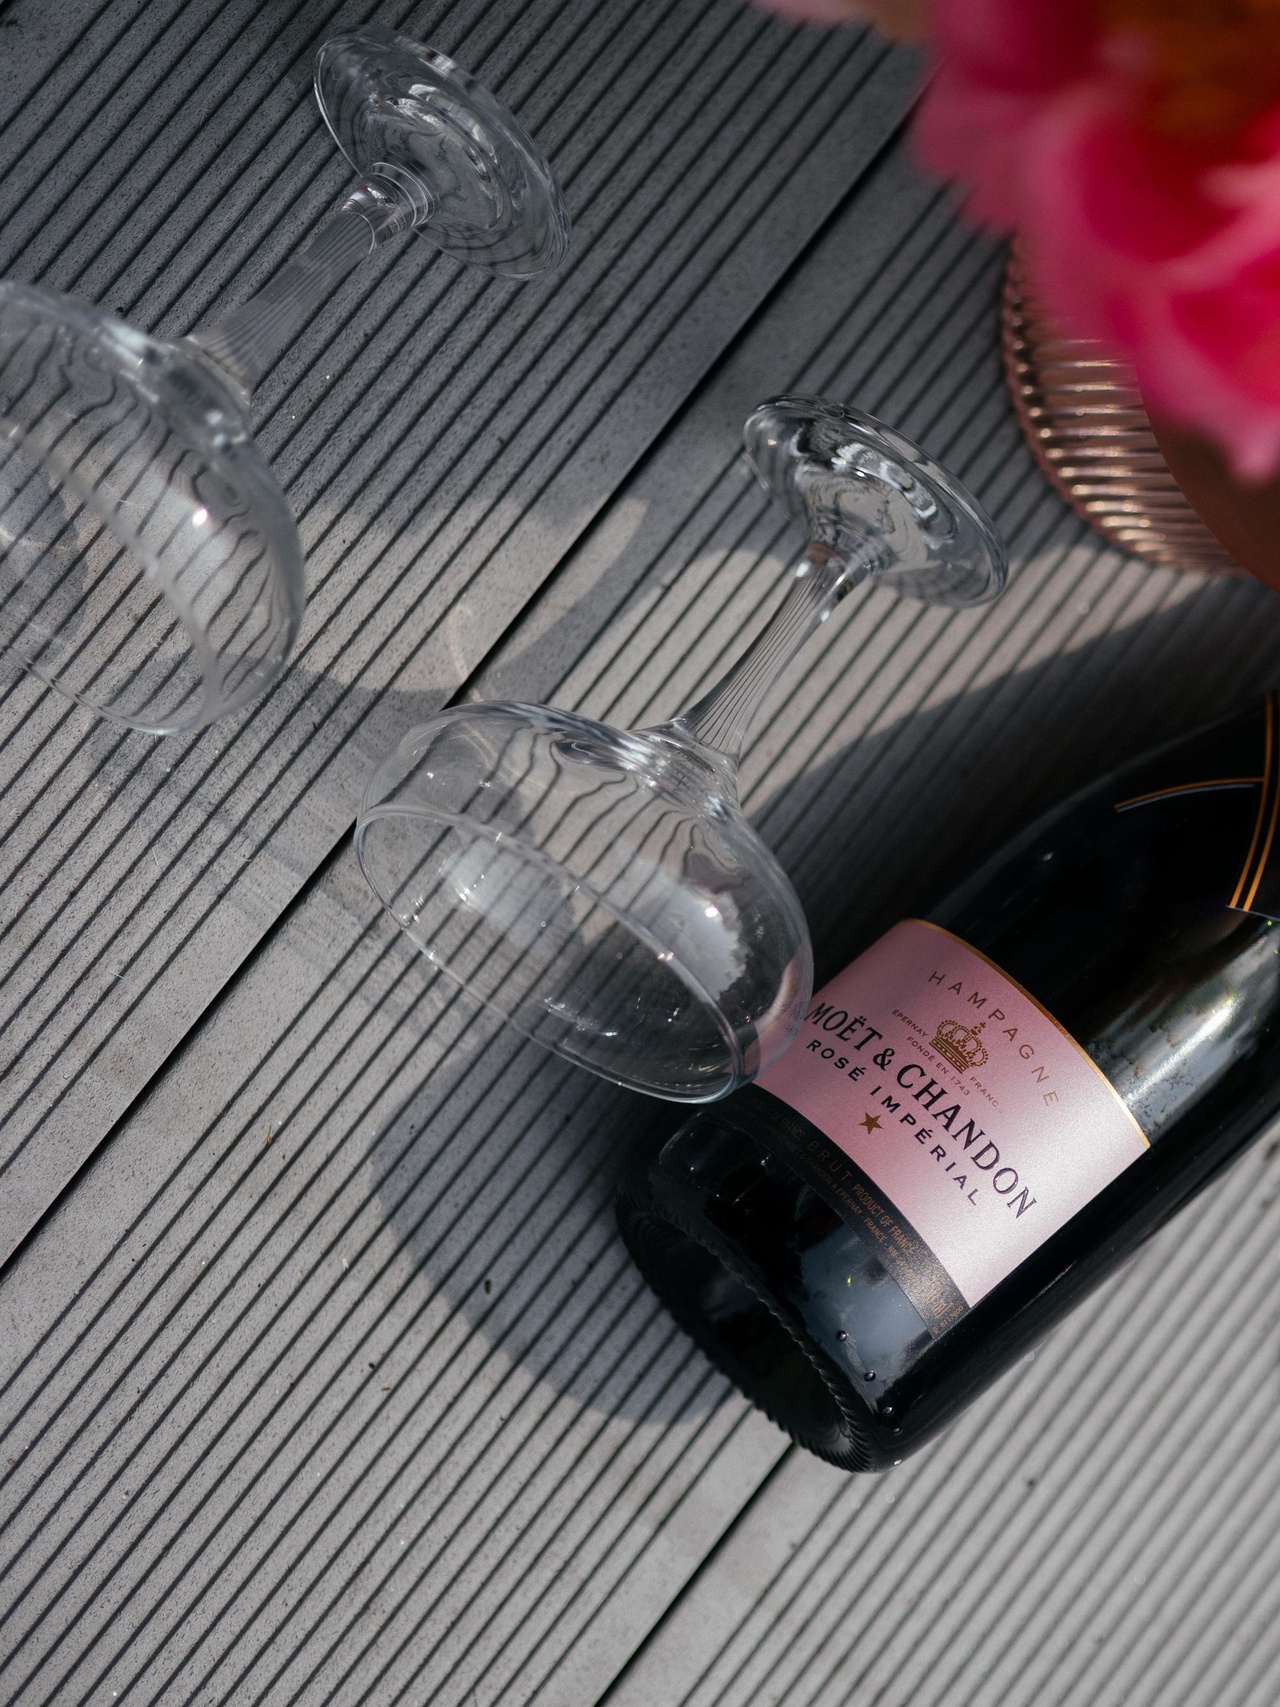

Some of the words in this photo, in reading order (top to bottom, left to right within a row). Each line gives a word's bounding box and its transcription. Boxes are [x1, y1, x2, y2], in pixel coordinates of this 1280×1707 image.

[906, 1036, 936, 1062] FONDÉ
[936, 1062, 949, 1075] EN
[950, 1076, 971, 1096] 1743
[926, 970, 1060, 1107] HAMPAGNE
[969, 1076, 1000, 1108] FRANC
[804, 1002, 883, 1051] MOËT
[873, 1047, 895, 1072] &
[896, 1063, 1037, 1219] CHANDON
[806, 1039, 868, 1082] ROSÉ
[870, 1085, 979, 1206] IMPÉRIAL
[807, 1140, 853, 1181] BRUT
[851, 1183, 884, 1218] PRODUCT
[880, 1215, 894, 1227] OF
[888, 1225, 917, 1256] FRANCE
[864, 1217, 888, 1244] FRANCE
